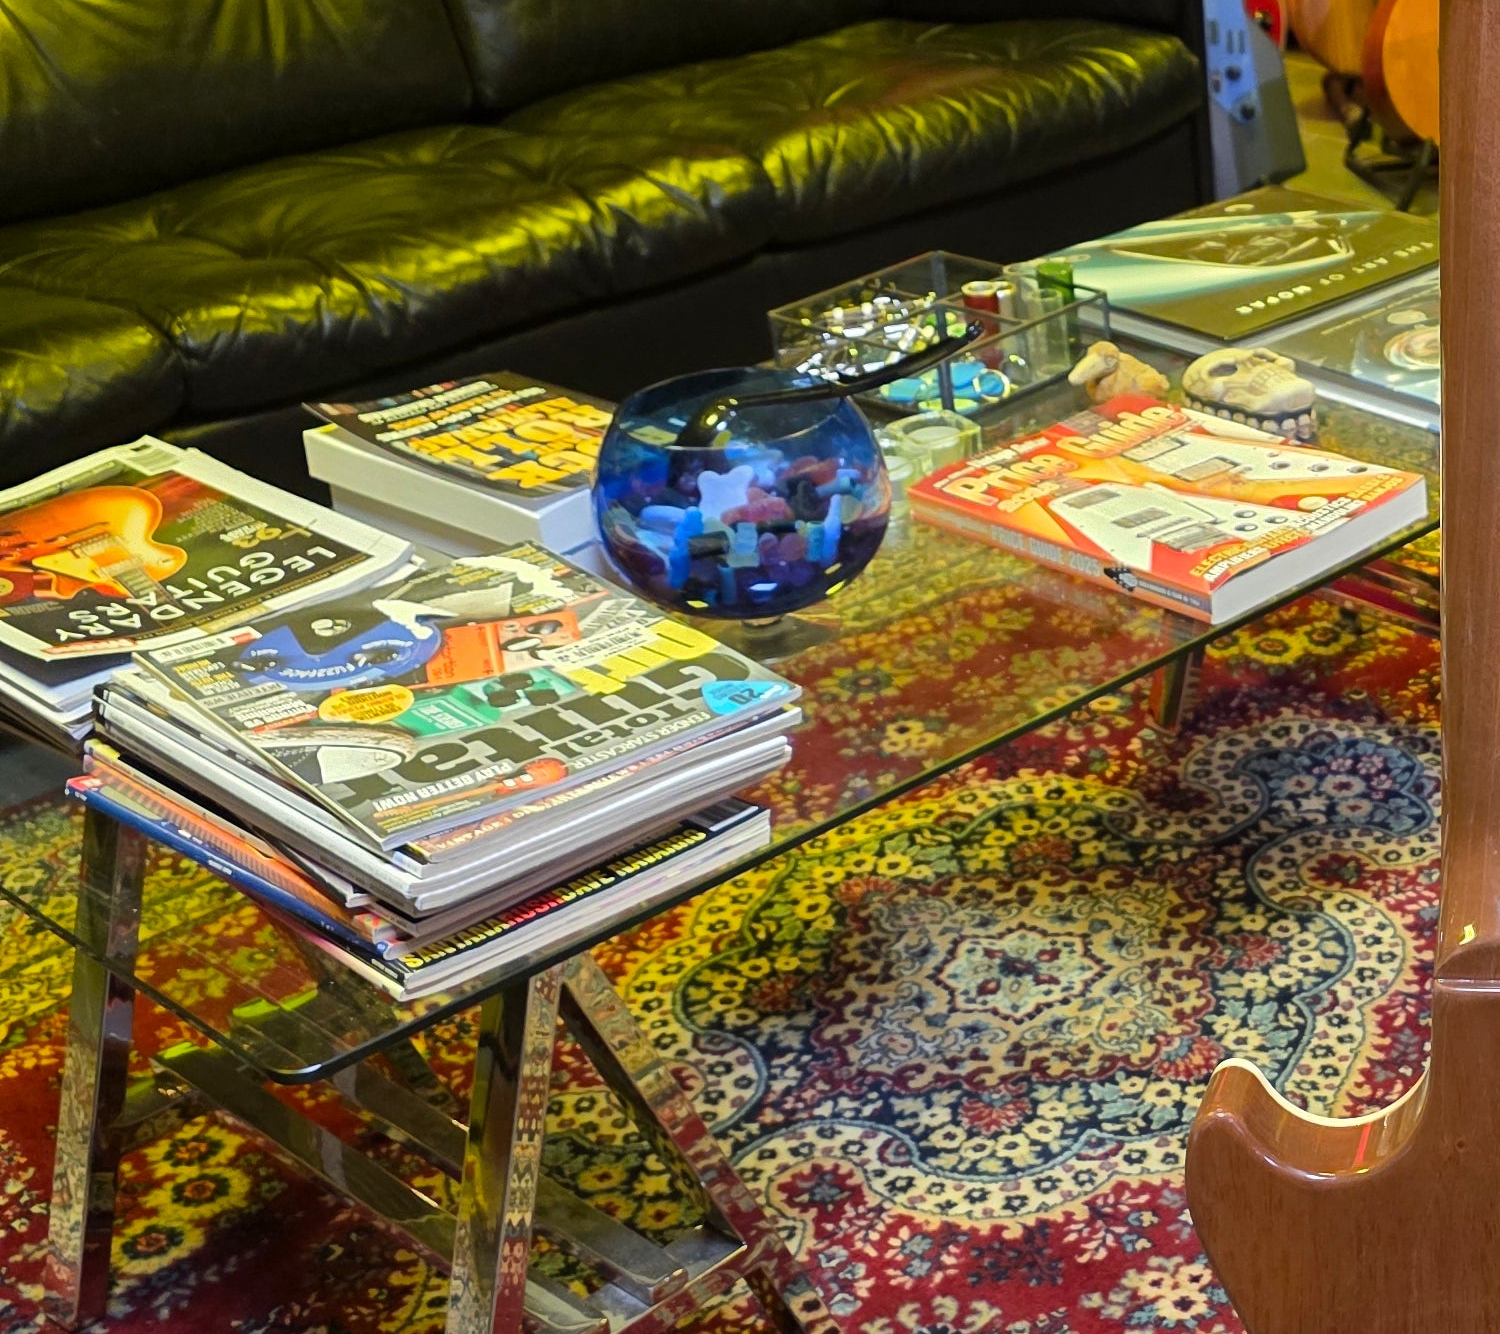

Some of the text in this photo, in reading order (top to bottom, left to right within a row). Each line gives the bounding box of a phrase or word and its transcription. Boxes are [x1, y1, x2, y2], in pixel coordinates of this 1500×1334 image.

[942, 404, 1187, 505] Price Guide
[55, 546, 336, 642] LEGENDARY
[68, 551, 275, 624] GUITARS
[318, 651, 752, 809] Guitar
[473, 761, 513, 780] PLAY
[550, 701, 697, 759] Total
[573, 711, 712, 769] FENDER STARCASTER
[401, 828, 707, 968] SANTANA RUSH DAVE NAVARRO
